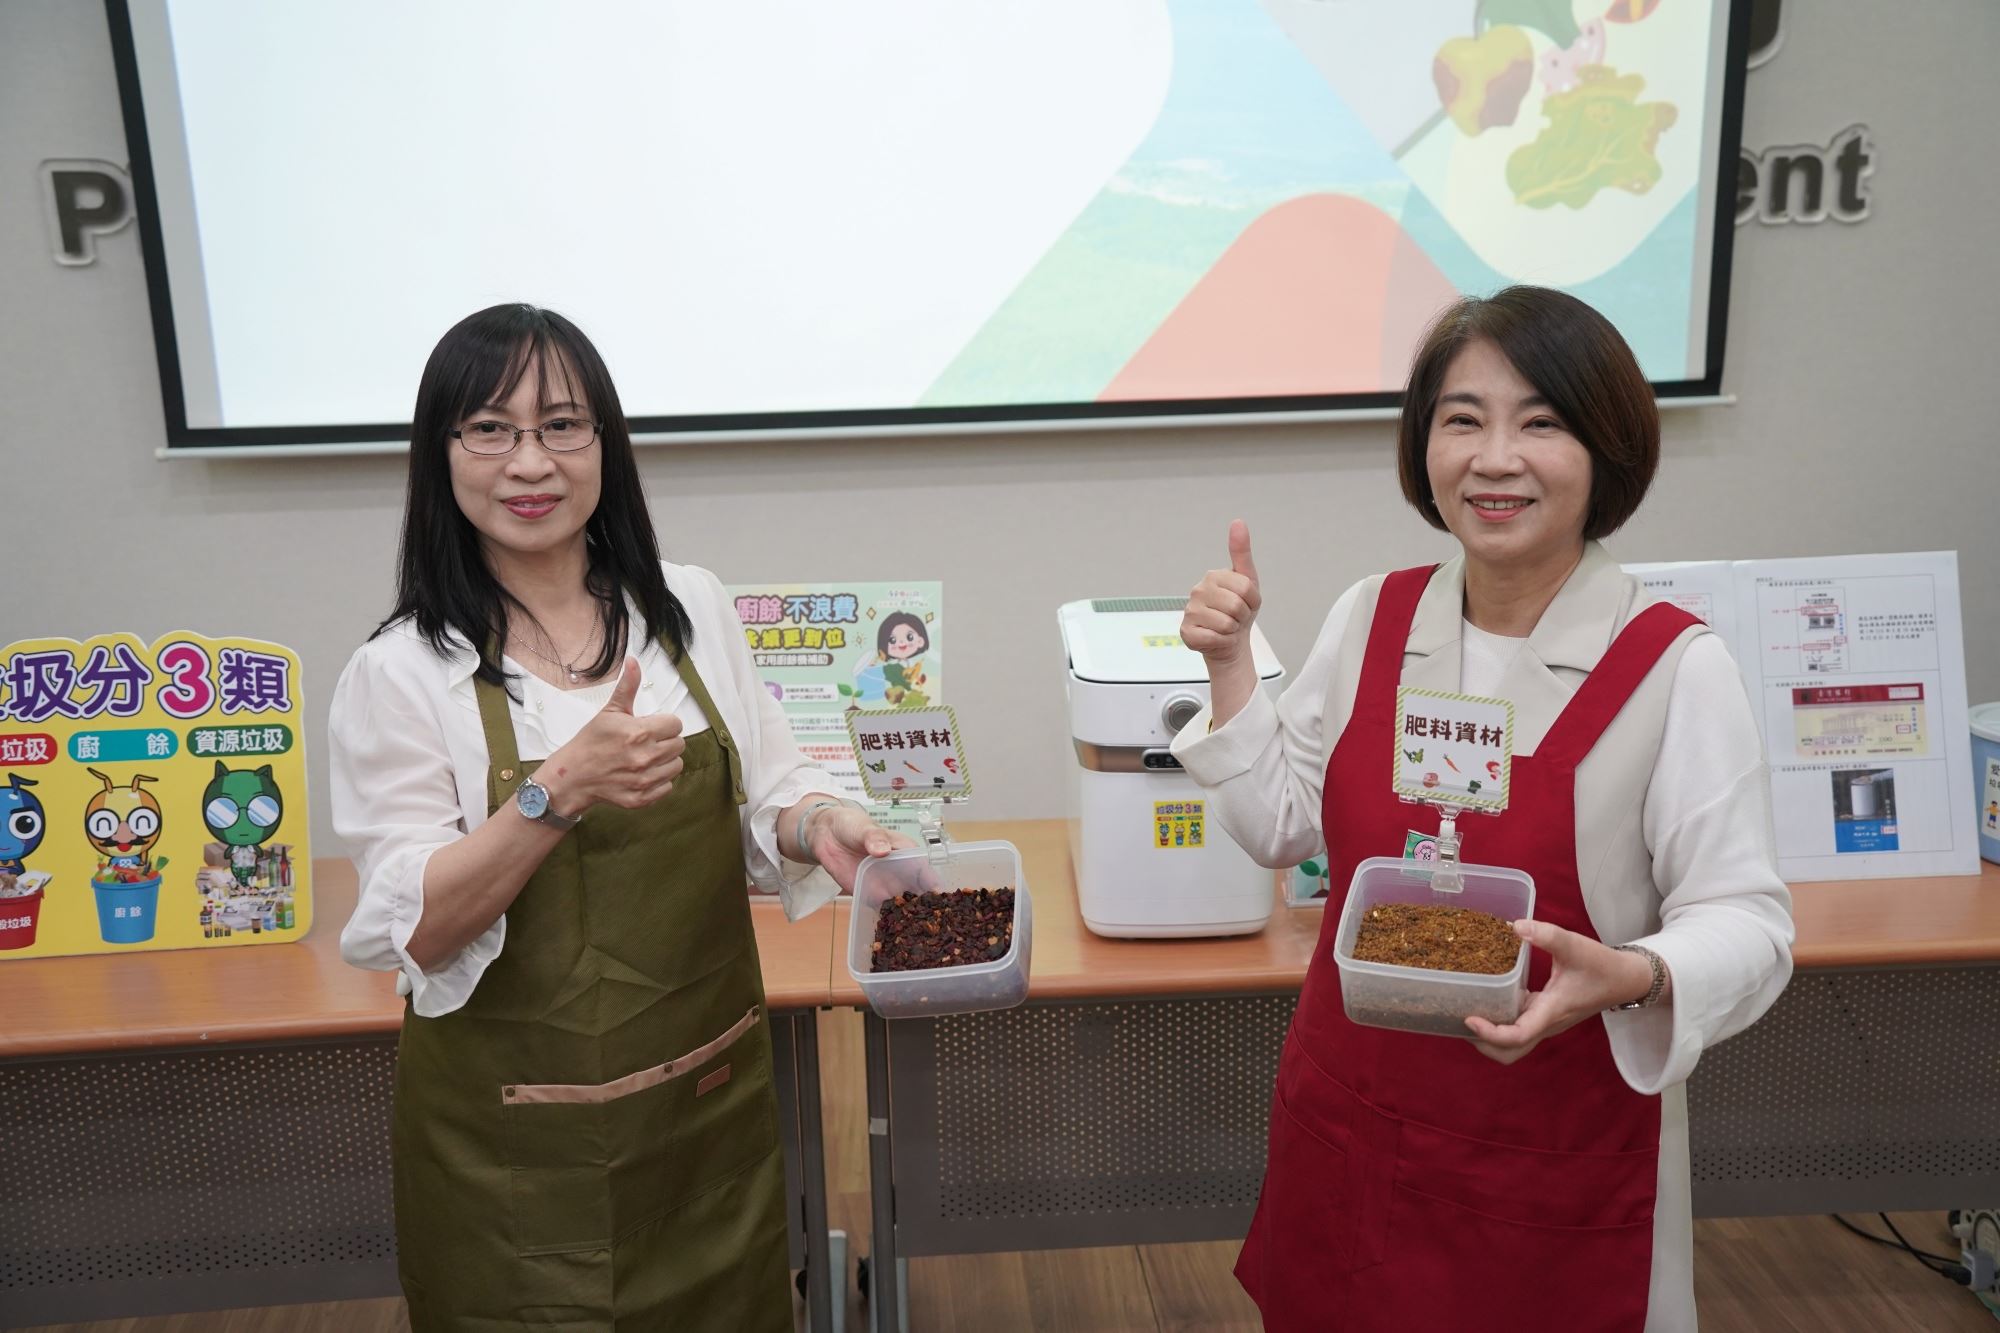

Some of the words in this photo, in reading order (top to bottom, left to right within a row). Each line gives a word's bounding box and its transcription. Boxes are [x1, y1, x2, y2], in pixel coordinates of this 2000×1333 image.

[735, 594, 858, 624] 廚餘不浪費
[0, 642, 292, 721] 圾分3類
[195, 728, 285, 754] 資源垃圾
[859, 728, 951, 751] 肥料資材
[1404, 714, 1503, 747] 肥料資材
[0, 738, 49, 763] 垃圾
